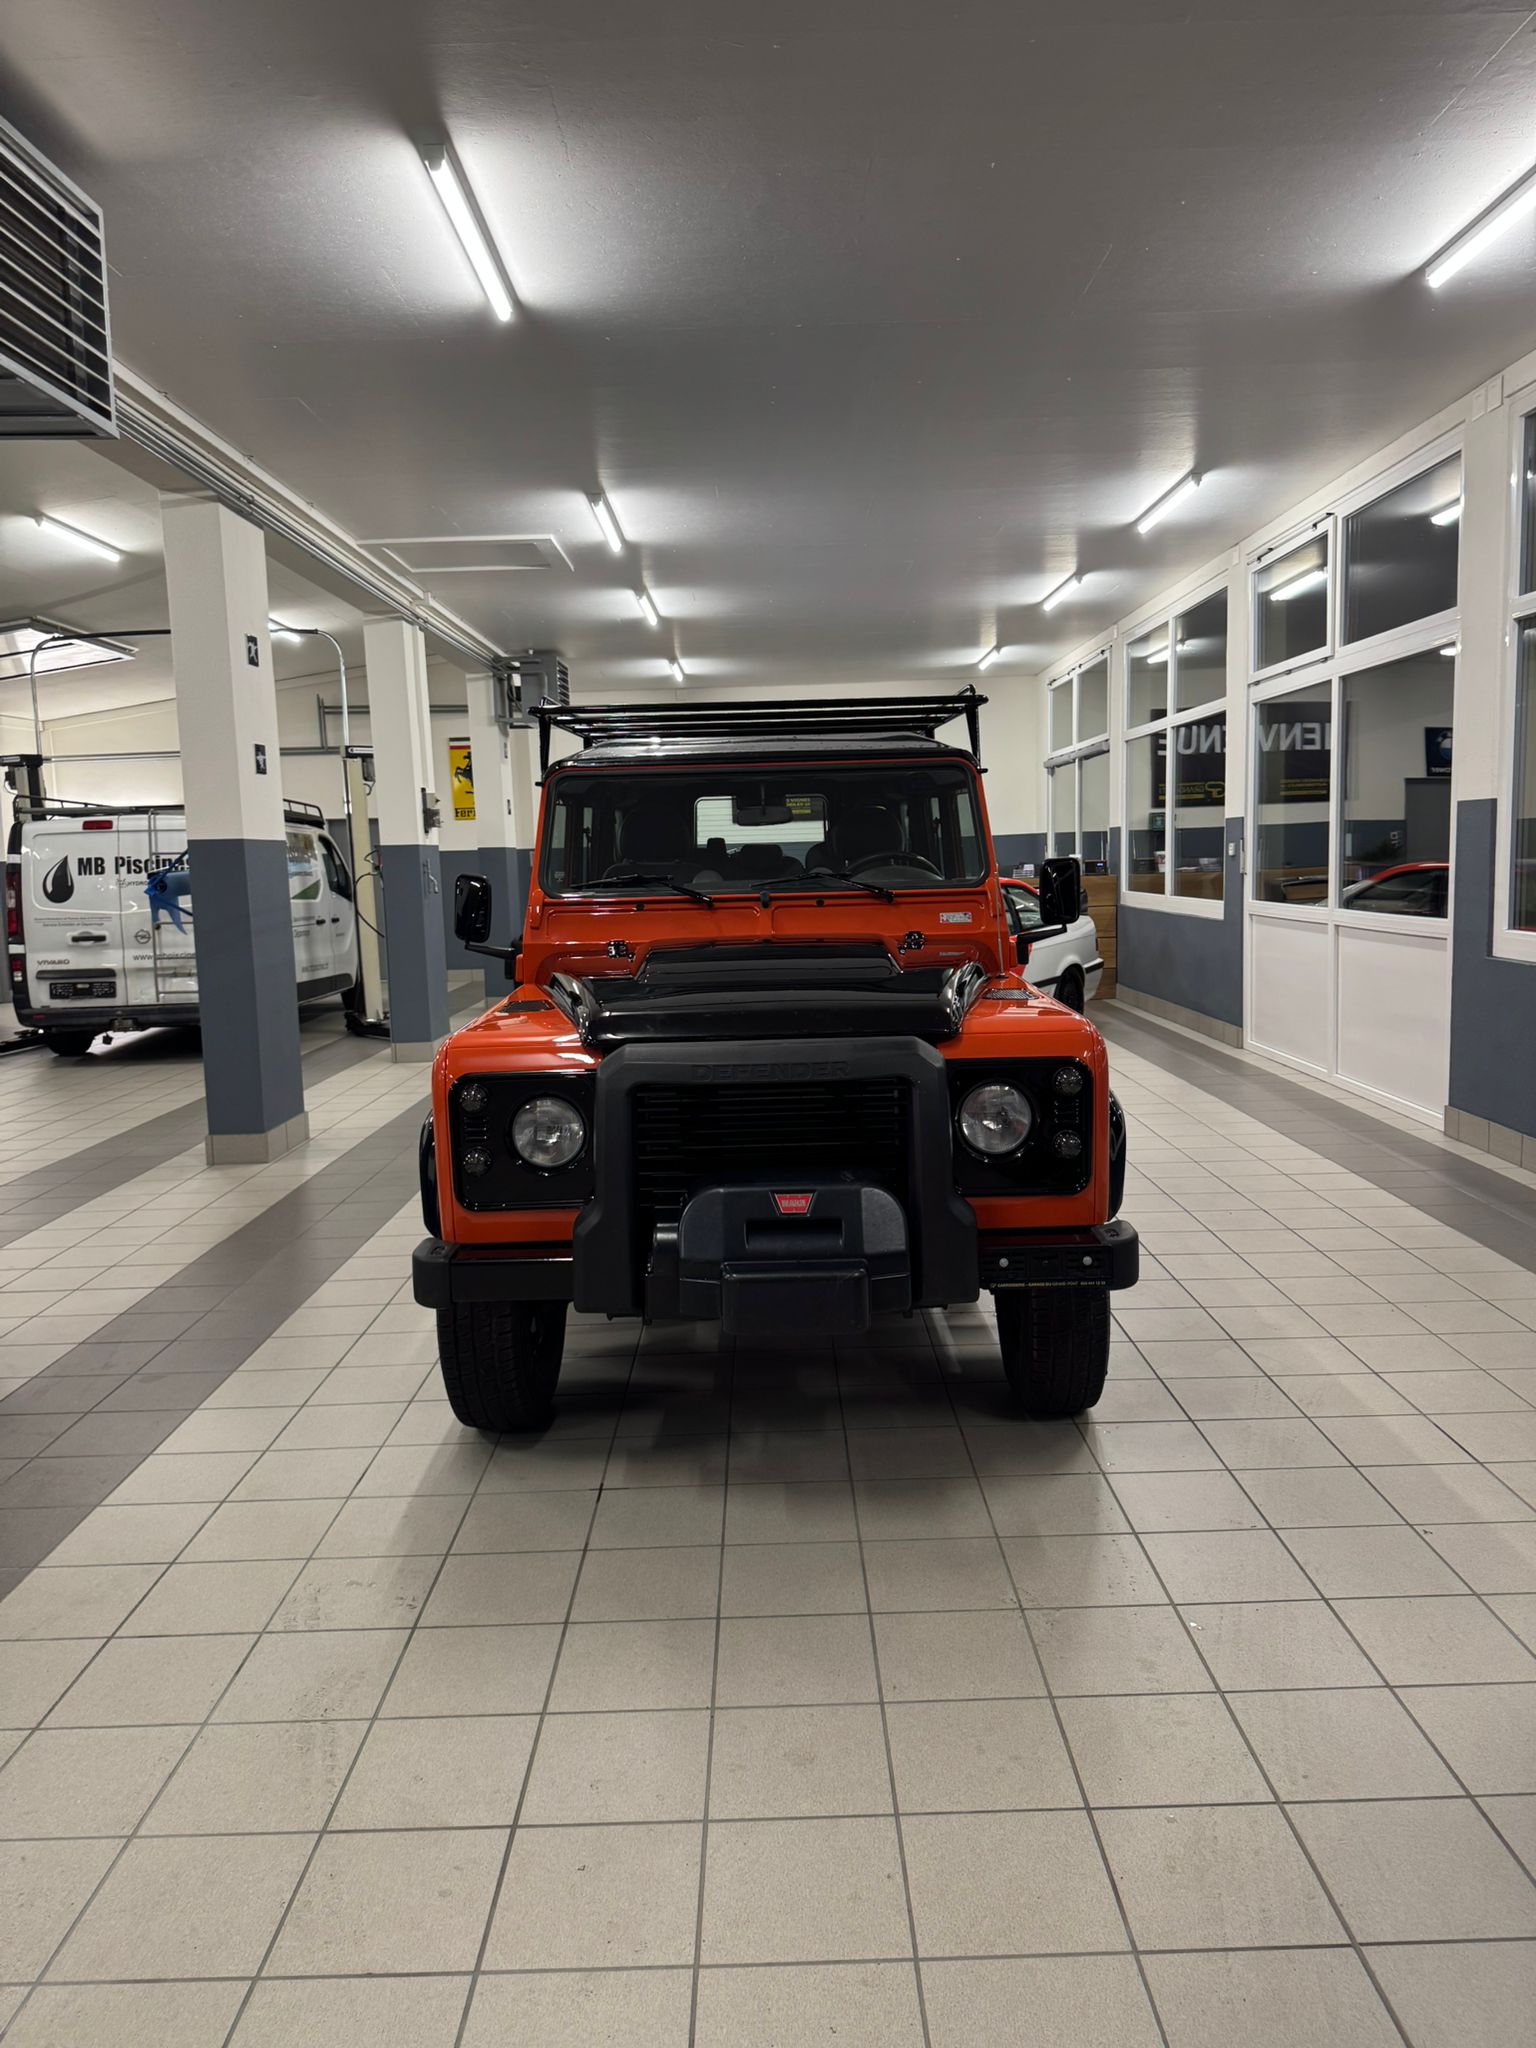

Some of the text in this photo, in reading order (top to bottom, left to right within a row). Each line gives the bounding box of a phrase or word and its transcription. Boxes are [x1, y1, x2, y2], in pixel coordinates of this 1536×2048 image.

[77, 855, 190, 876] MB Piscine
[37, 958, 70, 966] VIVARO
[691, 1061, 849, 1082] DEFENDER
